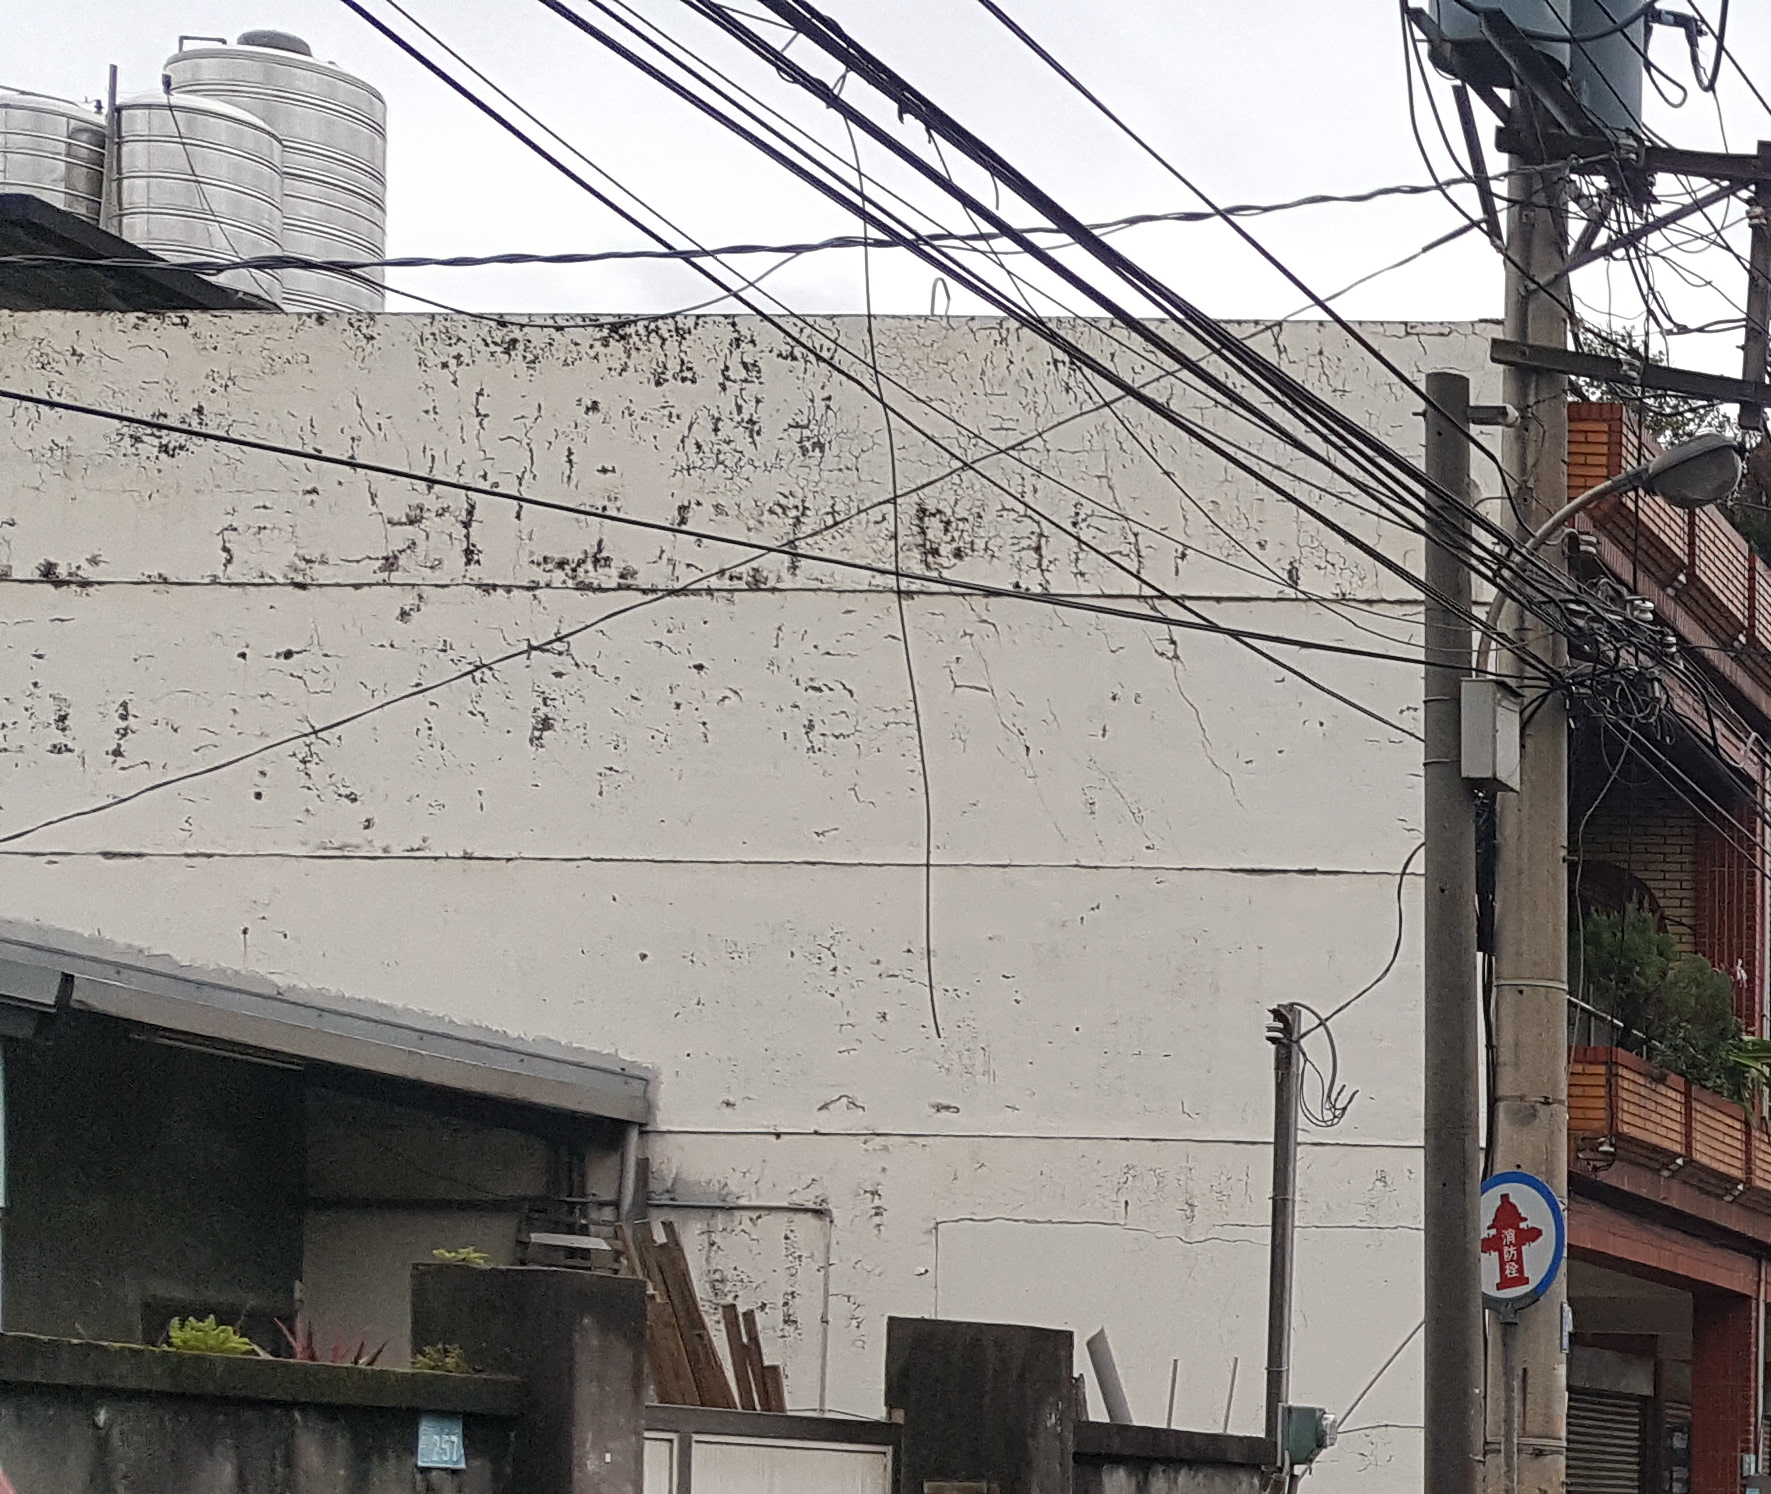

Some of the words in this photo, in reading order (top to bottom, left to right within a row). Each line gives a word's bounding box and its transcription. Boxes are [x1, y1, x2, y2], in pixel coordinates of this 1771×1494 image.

[1502, 1228, 1520, 1278] 消防栓
[431, 1434, 458, 1461] 257
